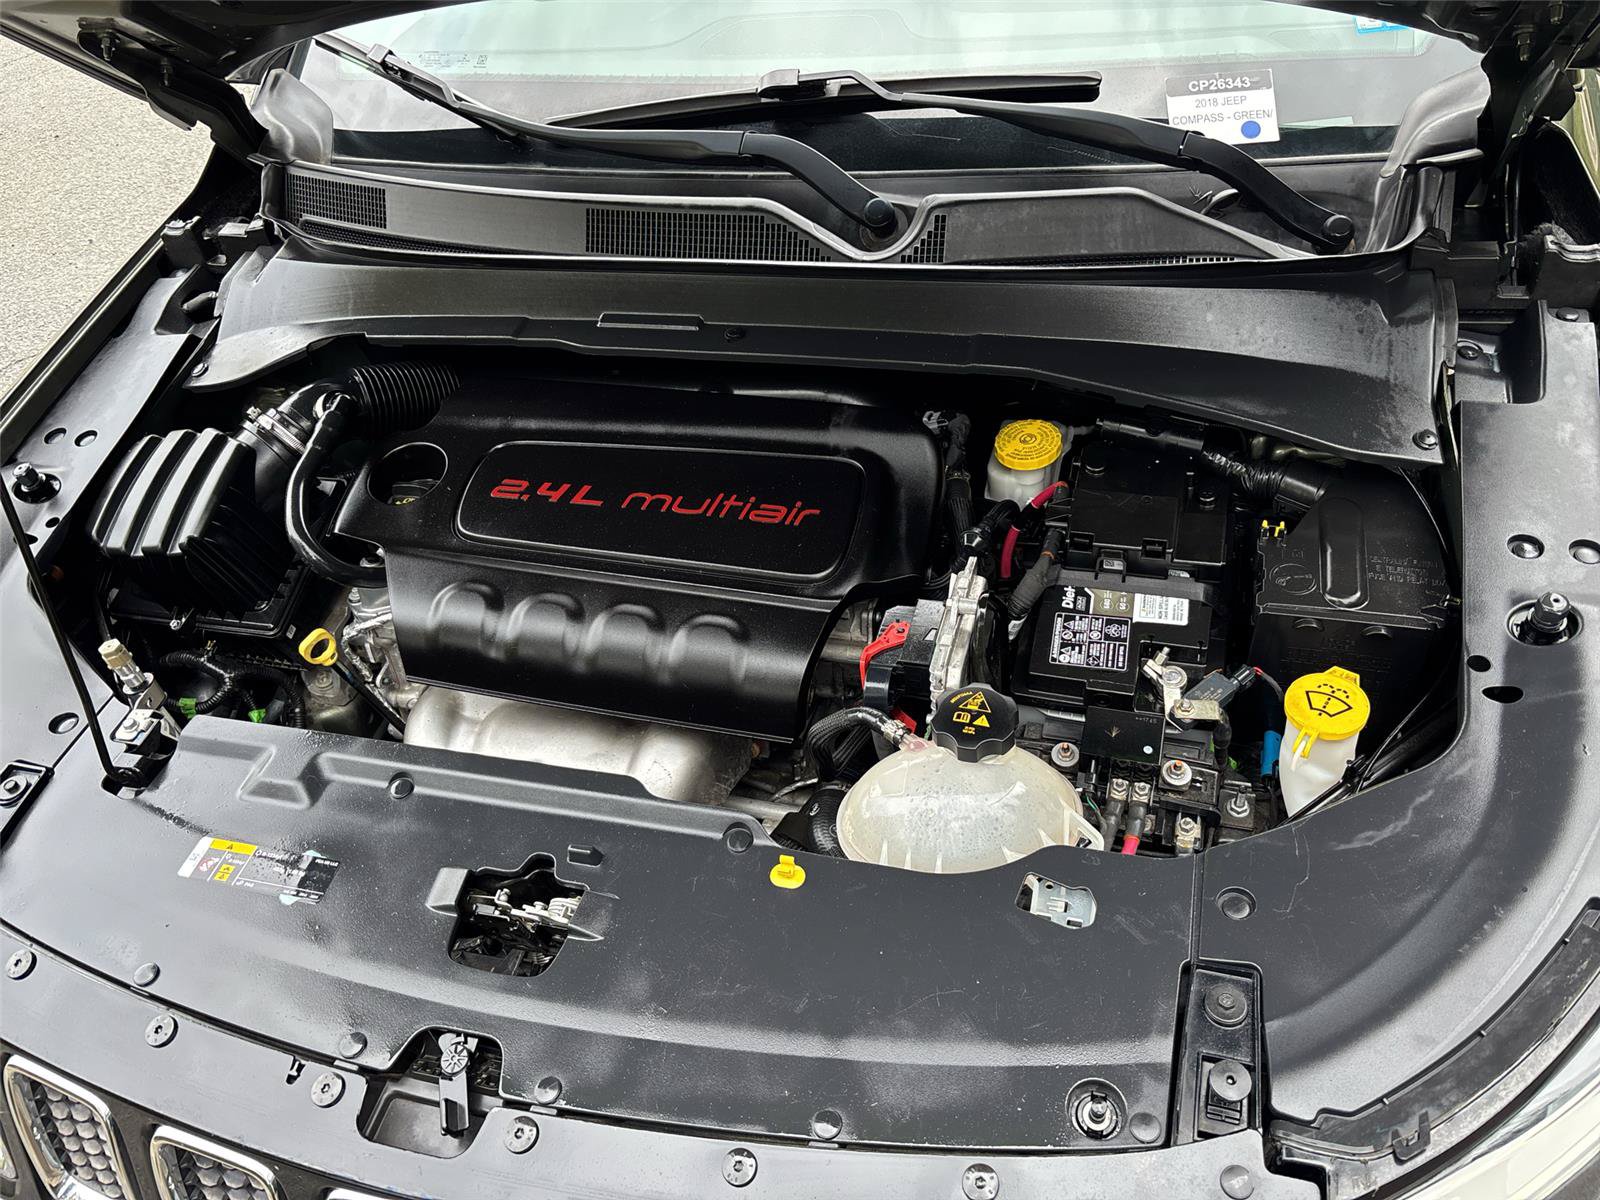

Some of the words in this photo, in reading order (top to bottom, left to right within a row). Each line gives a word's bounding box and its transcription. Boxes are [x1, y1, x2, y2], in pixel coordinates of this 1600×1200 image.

[1188, 76, 1251, 92] CP26343
[1195, 98, 1219, 109] 2018
[1221, 95, 1247, 106] JEEP
[1172, 112, 1225, 126] COMPASS
[1233, 108, 1273, 121] GREEN/
[490, 478, 604, 507] 2.4L
[621, 492, 822, 527] multiair
